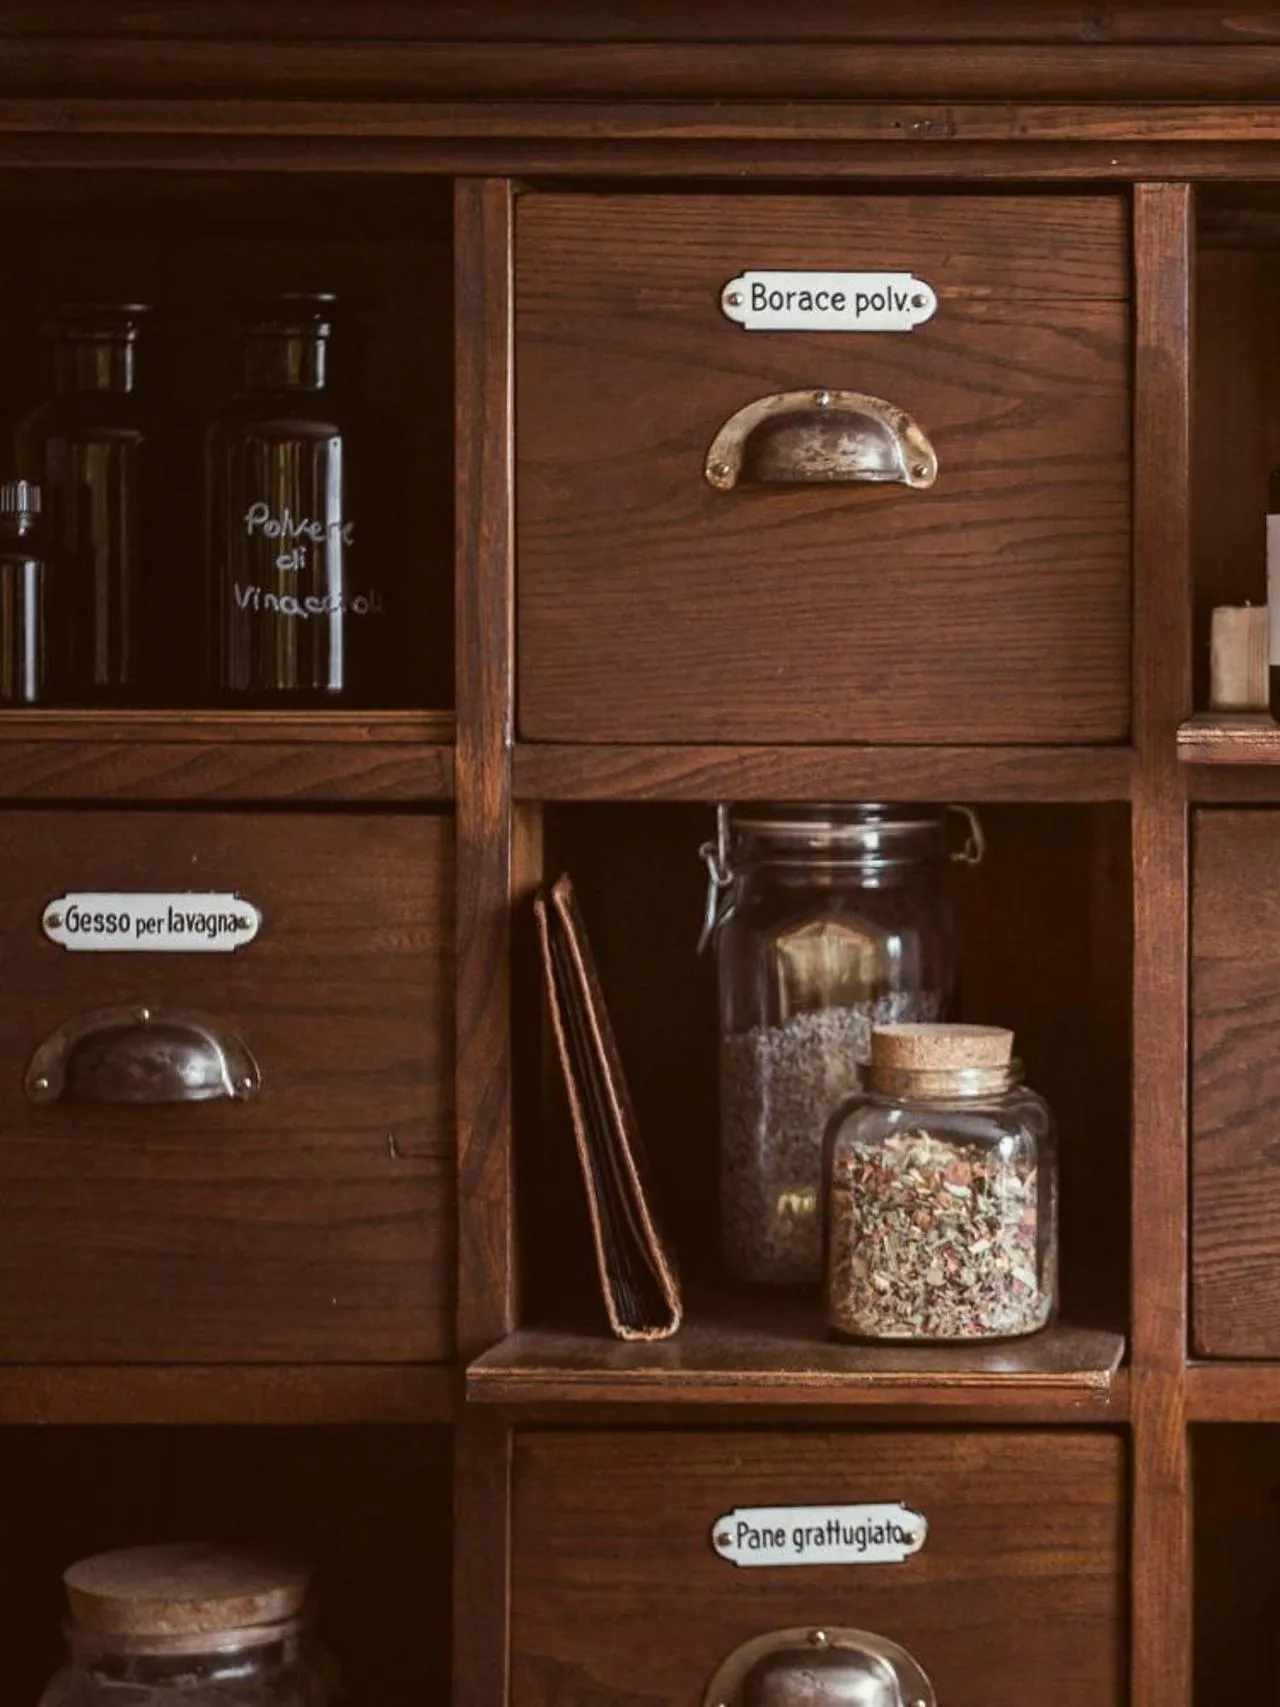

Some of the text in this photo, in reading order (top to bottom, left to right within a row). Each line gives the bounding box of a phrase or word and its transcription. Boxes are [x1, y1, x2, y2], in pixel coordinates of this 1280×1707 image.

[751, 282, 911, 319] Borace polv.
[276, 545, 306, 572] di
[65, 905, 237, 939] Gesso per lavagna
[736, 1517, 906, 1553] Pane grattugiato
